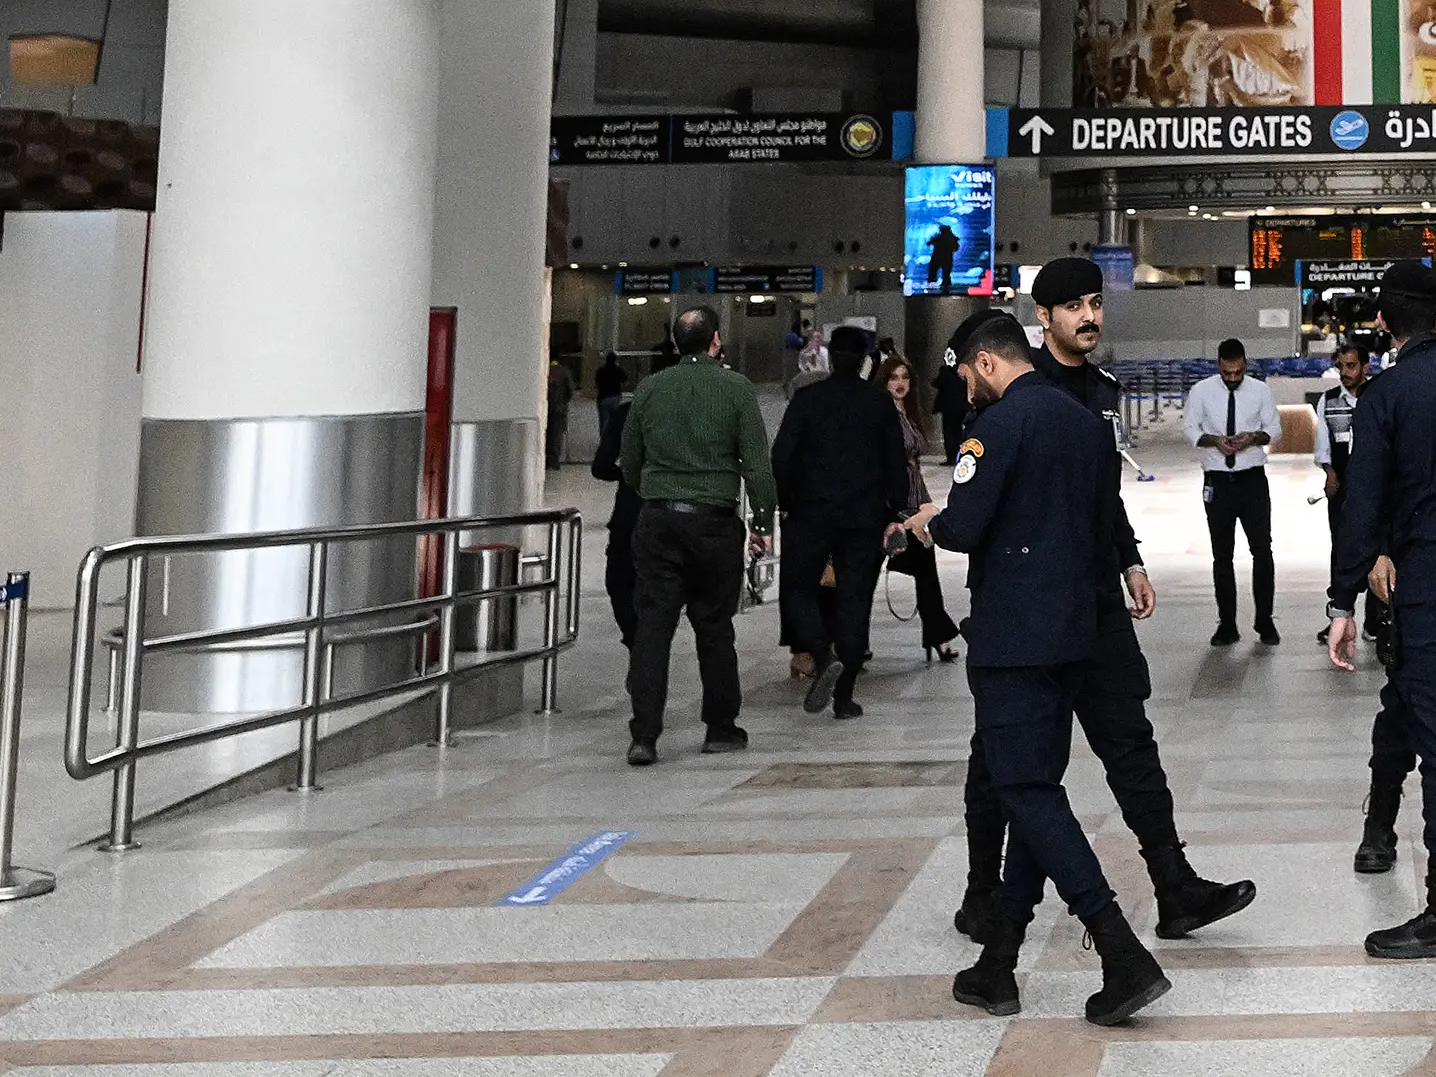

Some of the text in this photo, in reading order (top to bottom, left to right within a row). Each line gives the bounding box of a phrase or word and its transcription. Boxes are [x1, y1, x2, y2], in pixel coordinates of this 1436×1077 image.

[1072, 115, 1313, 151] DEPARTURE GATES
[1308, 272, 1375, 282] DEPARTURE
